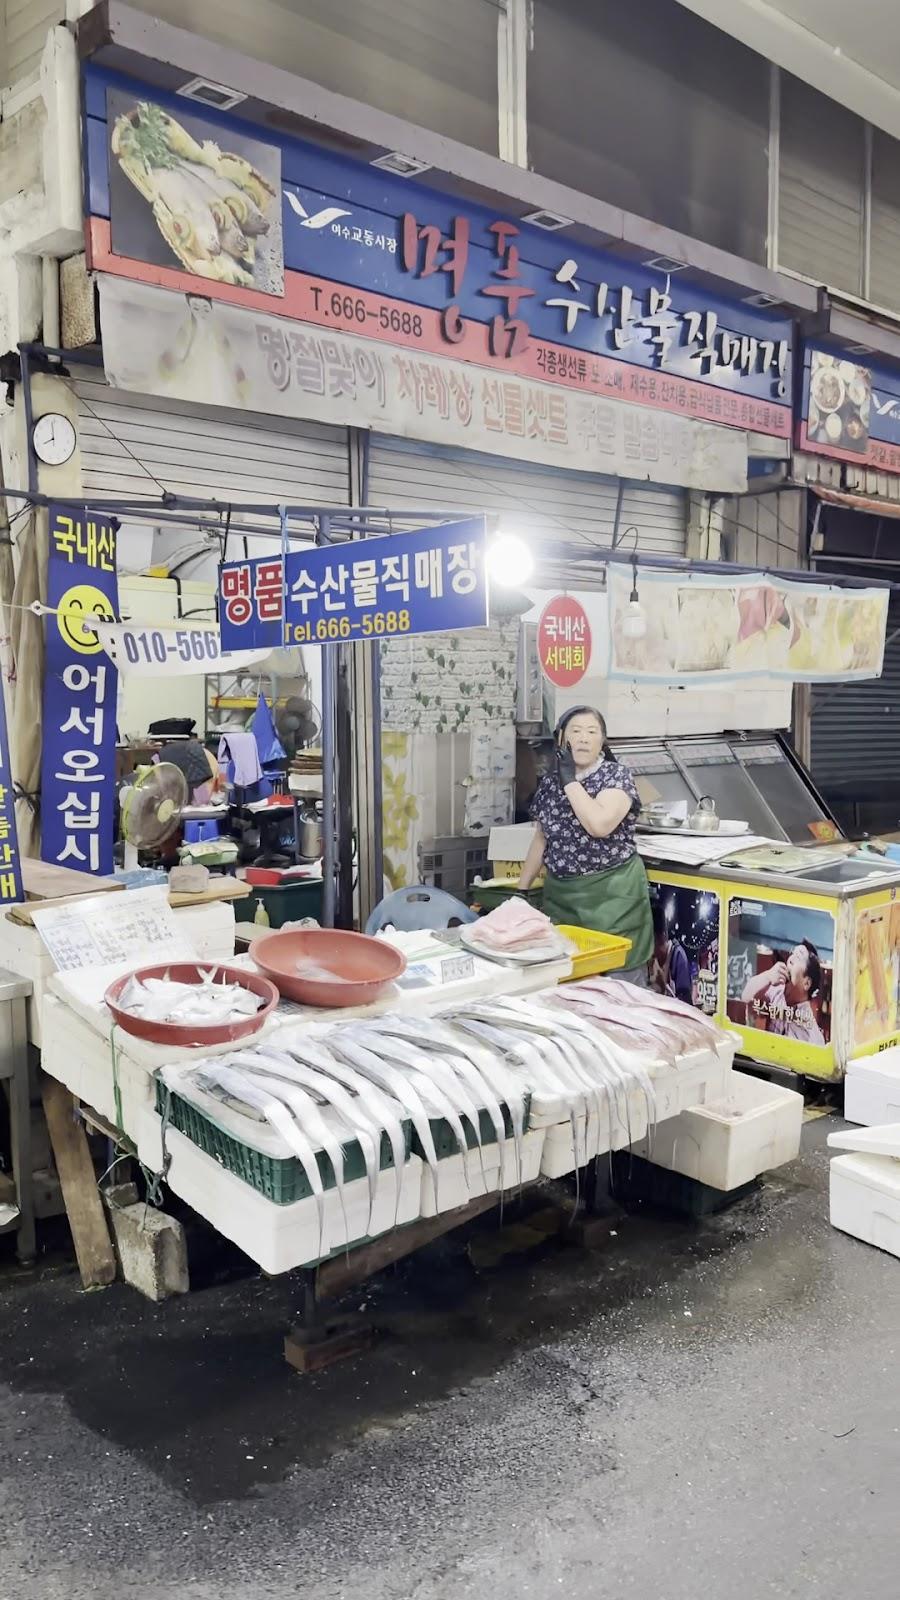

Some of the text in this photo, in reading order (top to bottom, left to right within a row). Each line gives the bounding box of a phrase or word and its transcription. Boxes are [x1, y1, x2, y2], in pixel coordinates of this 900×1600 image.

[402, 211, 537, 358] 명품
[309, 286, 423, 338] T.666-5688
[255, 323, 386, 408] 명절맞이
[391, 353, 474, 427] 차례상
[481, 377, 569, 445] 선물셋트
[536, 347, 587, 382] 각종생선류
[53, 515, 115, 572] 국내산
[221, 543, 482, 626] 명품 수산물직매장
[543, 615, 586, 642] 국내산
[545, 646, 585, 671] 서대회
